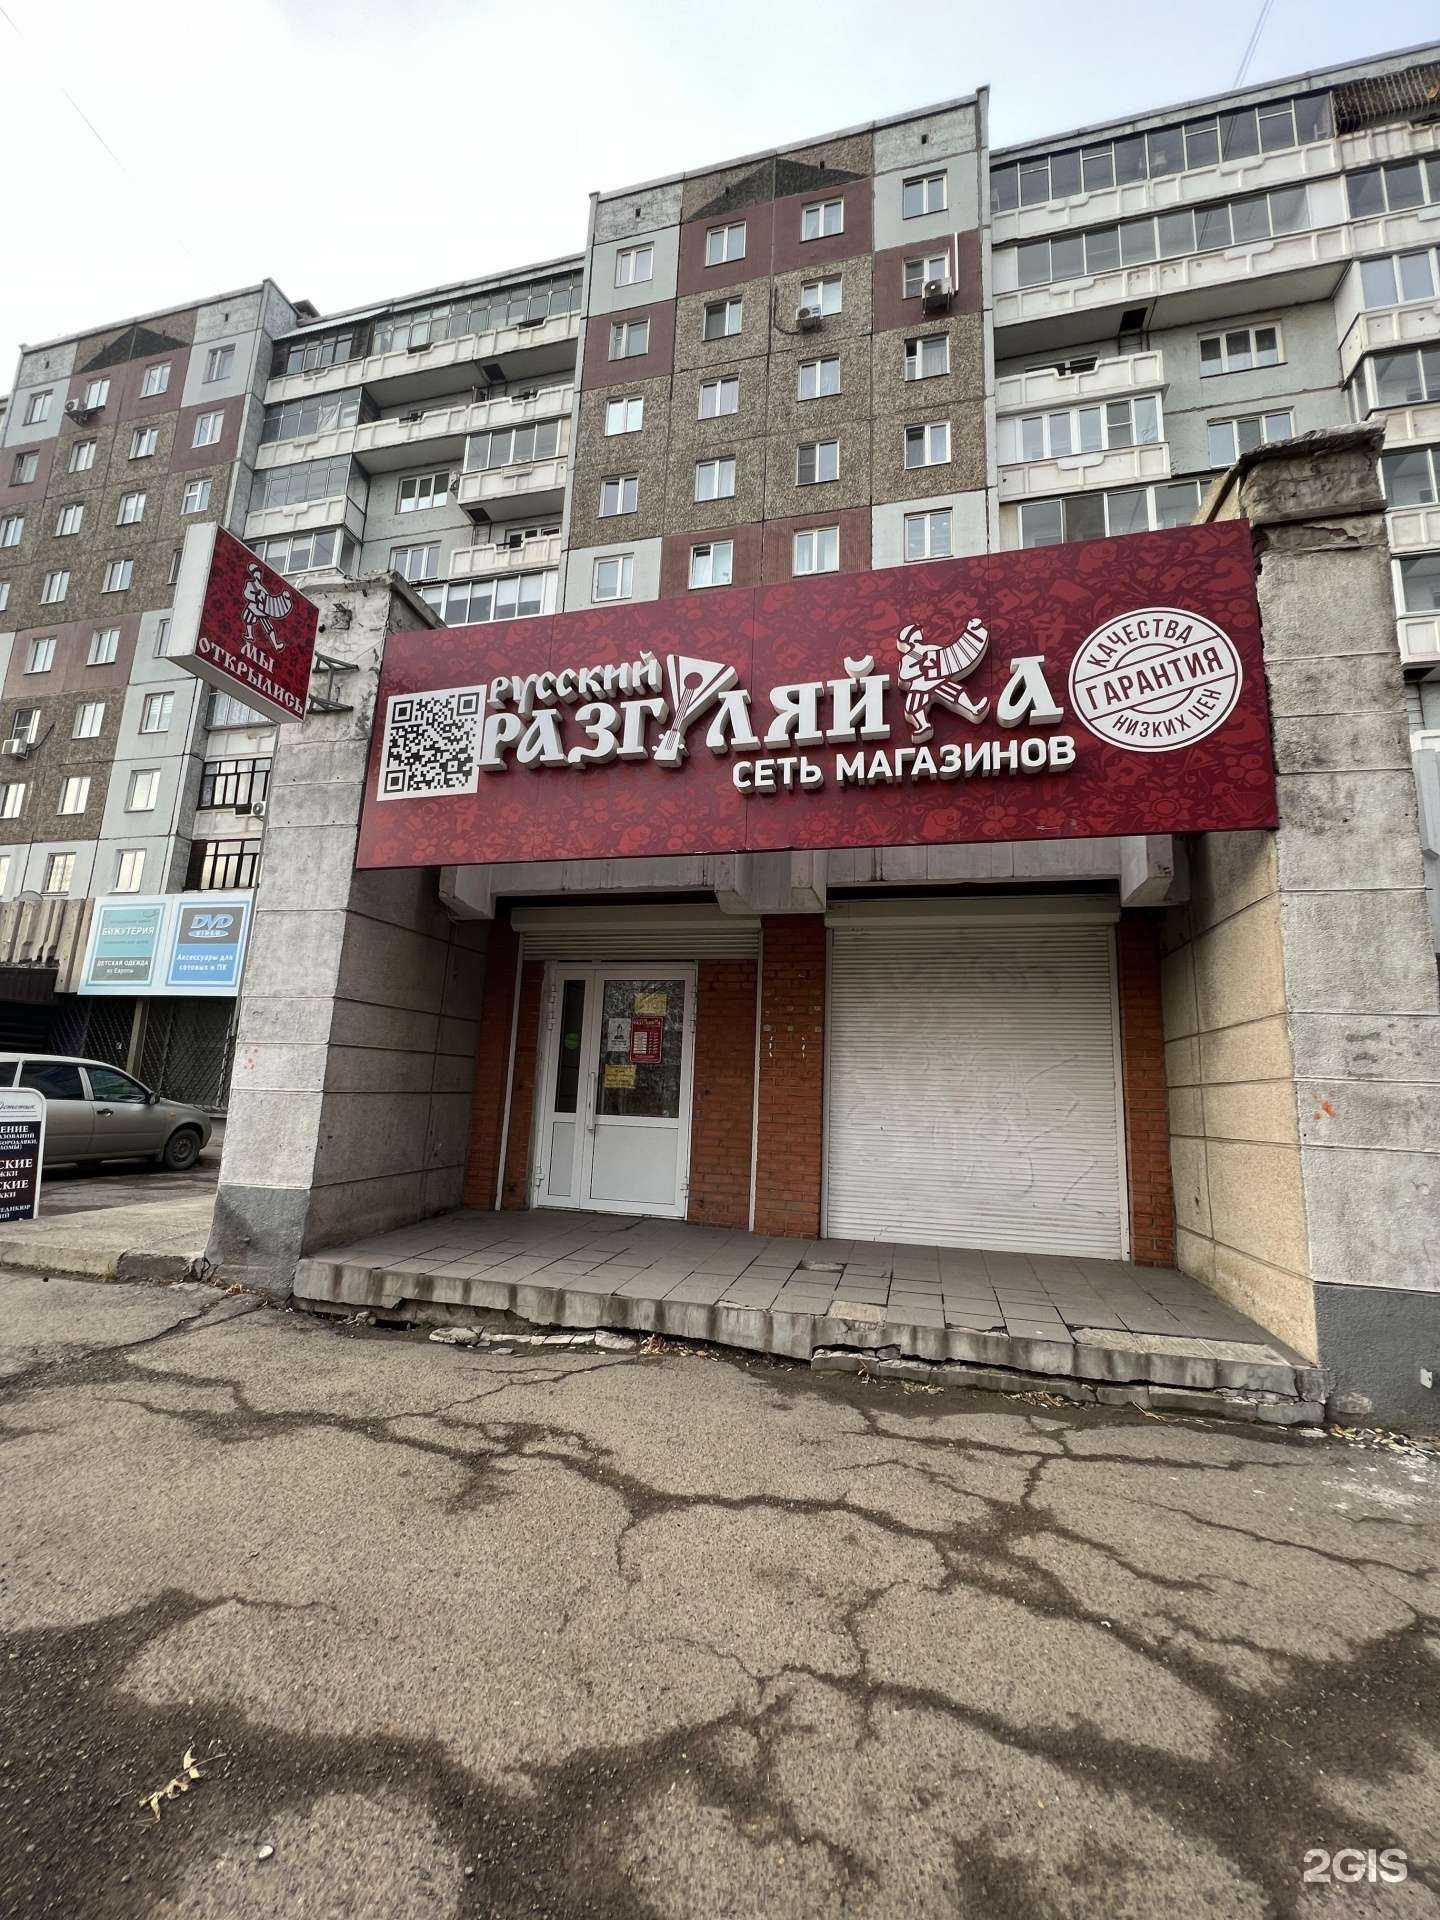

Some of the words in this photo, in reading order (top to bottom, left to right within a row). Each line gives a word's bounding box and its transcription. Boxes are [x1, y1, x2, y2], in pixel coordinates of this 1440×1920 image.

[241, 641, 275, 674] МЫ
[1087, 618, 1194, 669] КАЧЕСТВА
[199, 637, 304, 714] ОТКРЫЛИСЬ
[1085, 646, 1224, 711] ГАРАНТИЯ
[1112, 713, 1192, 738] НИЗКИХ
[1188, 688, 1222, 721] ЦЕН
[732, 754, 825, 794] СЕТЬ
[836, 734, 1077, 790] МАГАЗИНОВ
[190, 913, 234, 931] DVD
